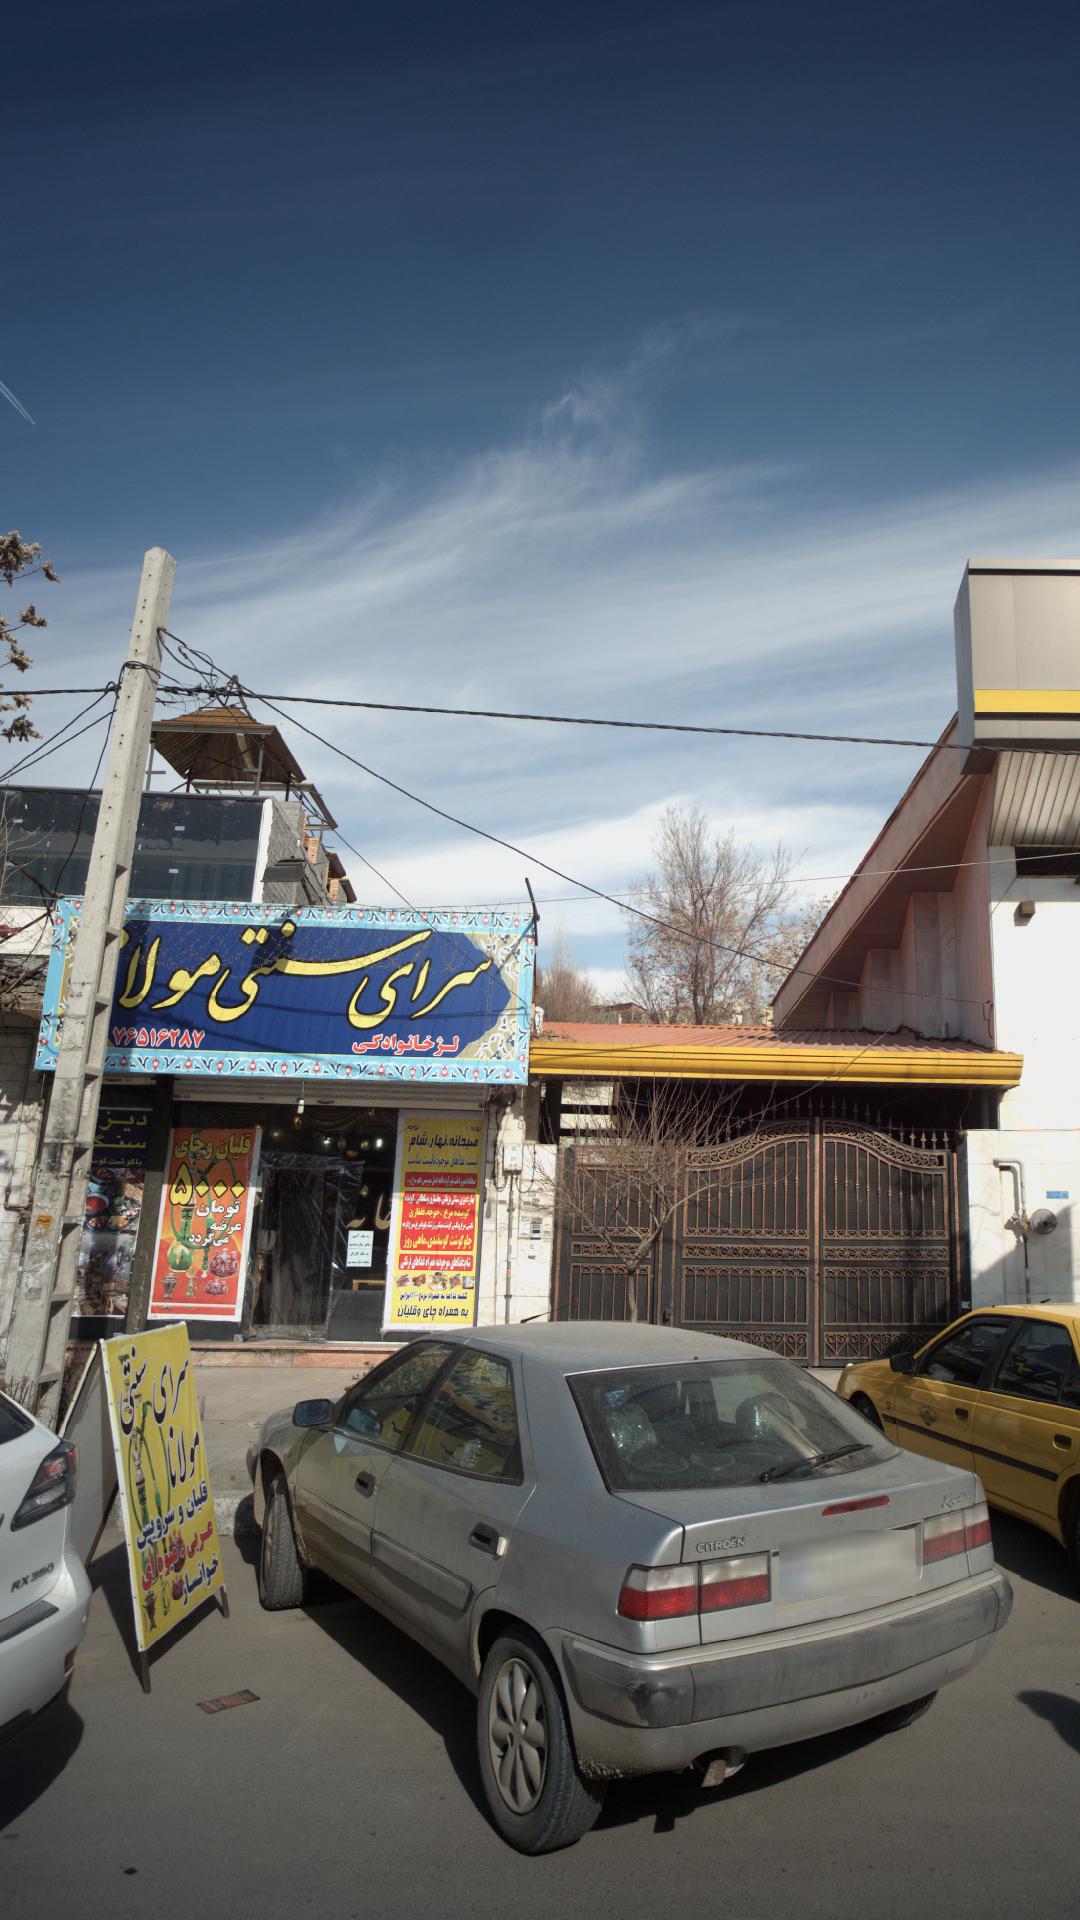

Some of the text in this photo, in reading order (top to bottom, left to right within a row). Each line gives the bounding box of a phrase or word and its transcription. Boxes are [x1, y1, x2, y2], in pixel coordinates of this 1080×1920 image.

[118, 919, 493, 1030] سرای سنتی مولا
[352, 1033, 460, 1057] لژ خانوادگی
[216, 1133, 251, 1160] قلیان
[169, 1162, 246, 1206] ۵۰۰۰
[195, 1200, 241, 1218] تومان
[209, 1220, 242, 1235] عرضه
[422, 1305, 437, 1321] چای
[438, 1305, 459, 1318] همراه
[119, 1346, 189, 1436] سرای سنتی
[167, 1425, 200, 1489] مولانا
[136, 1480, 208, 1550] قلیان و سرویس
[186, 1520, 213, 1559] عربی
[696, 1535, 746, 1553] CITROËN
[10, 1574, 30, 1593] RX
[182, 1552, 218, 1606] خوانسار
